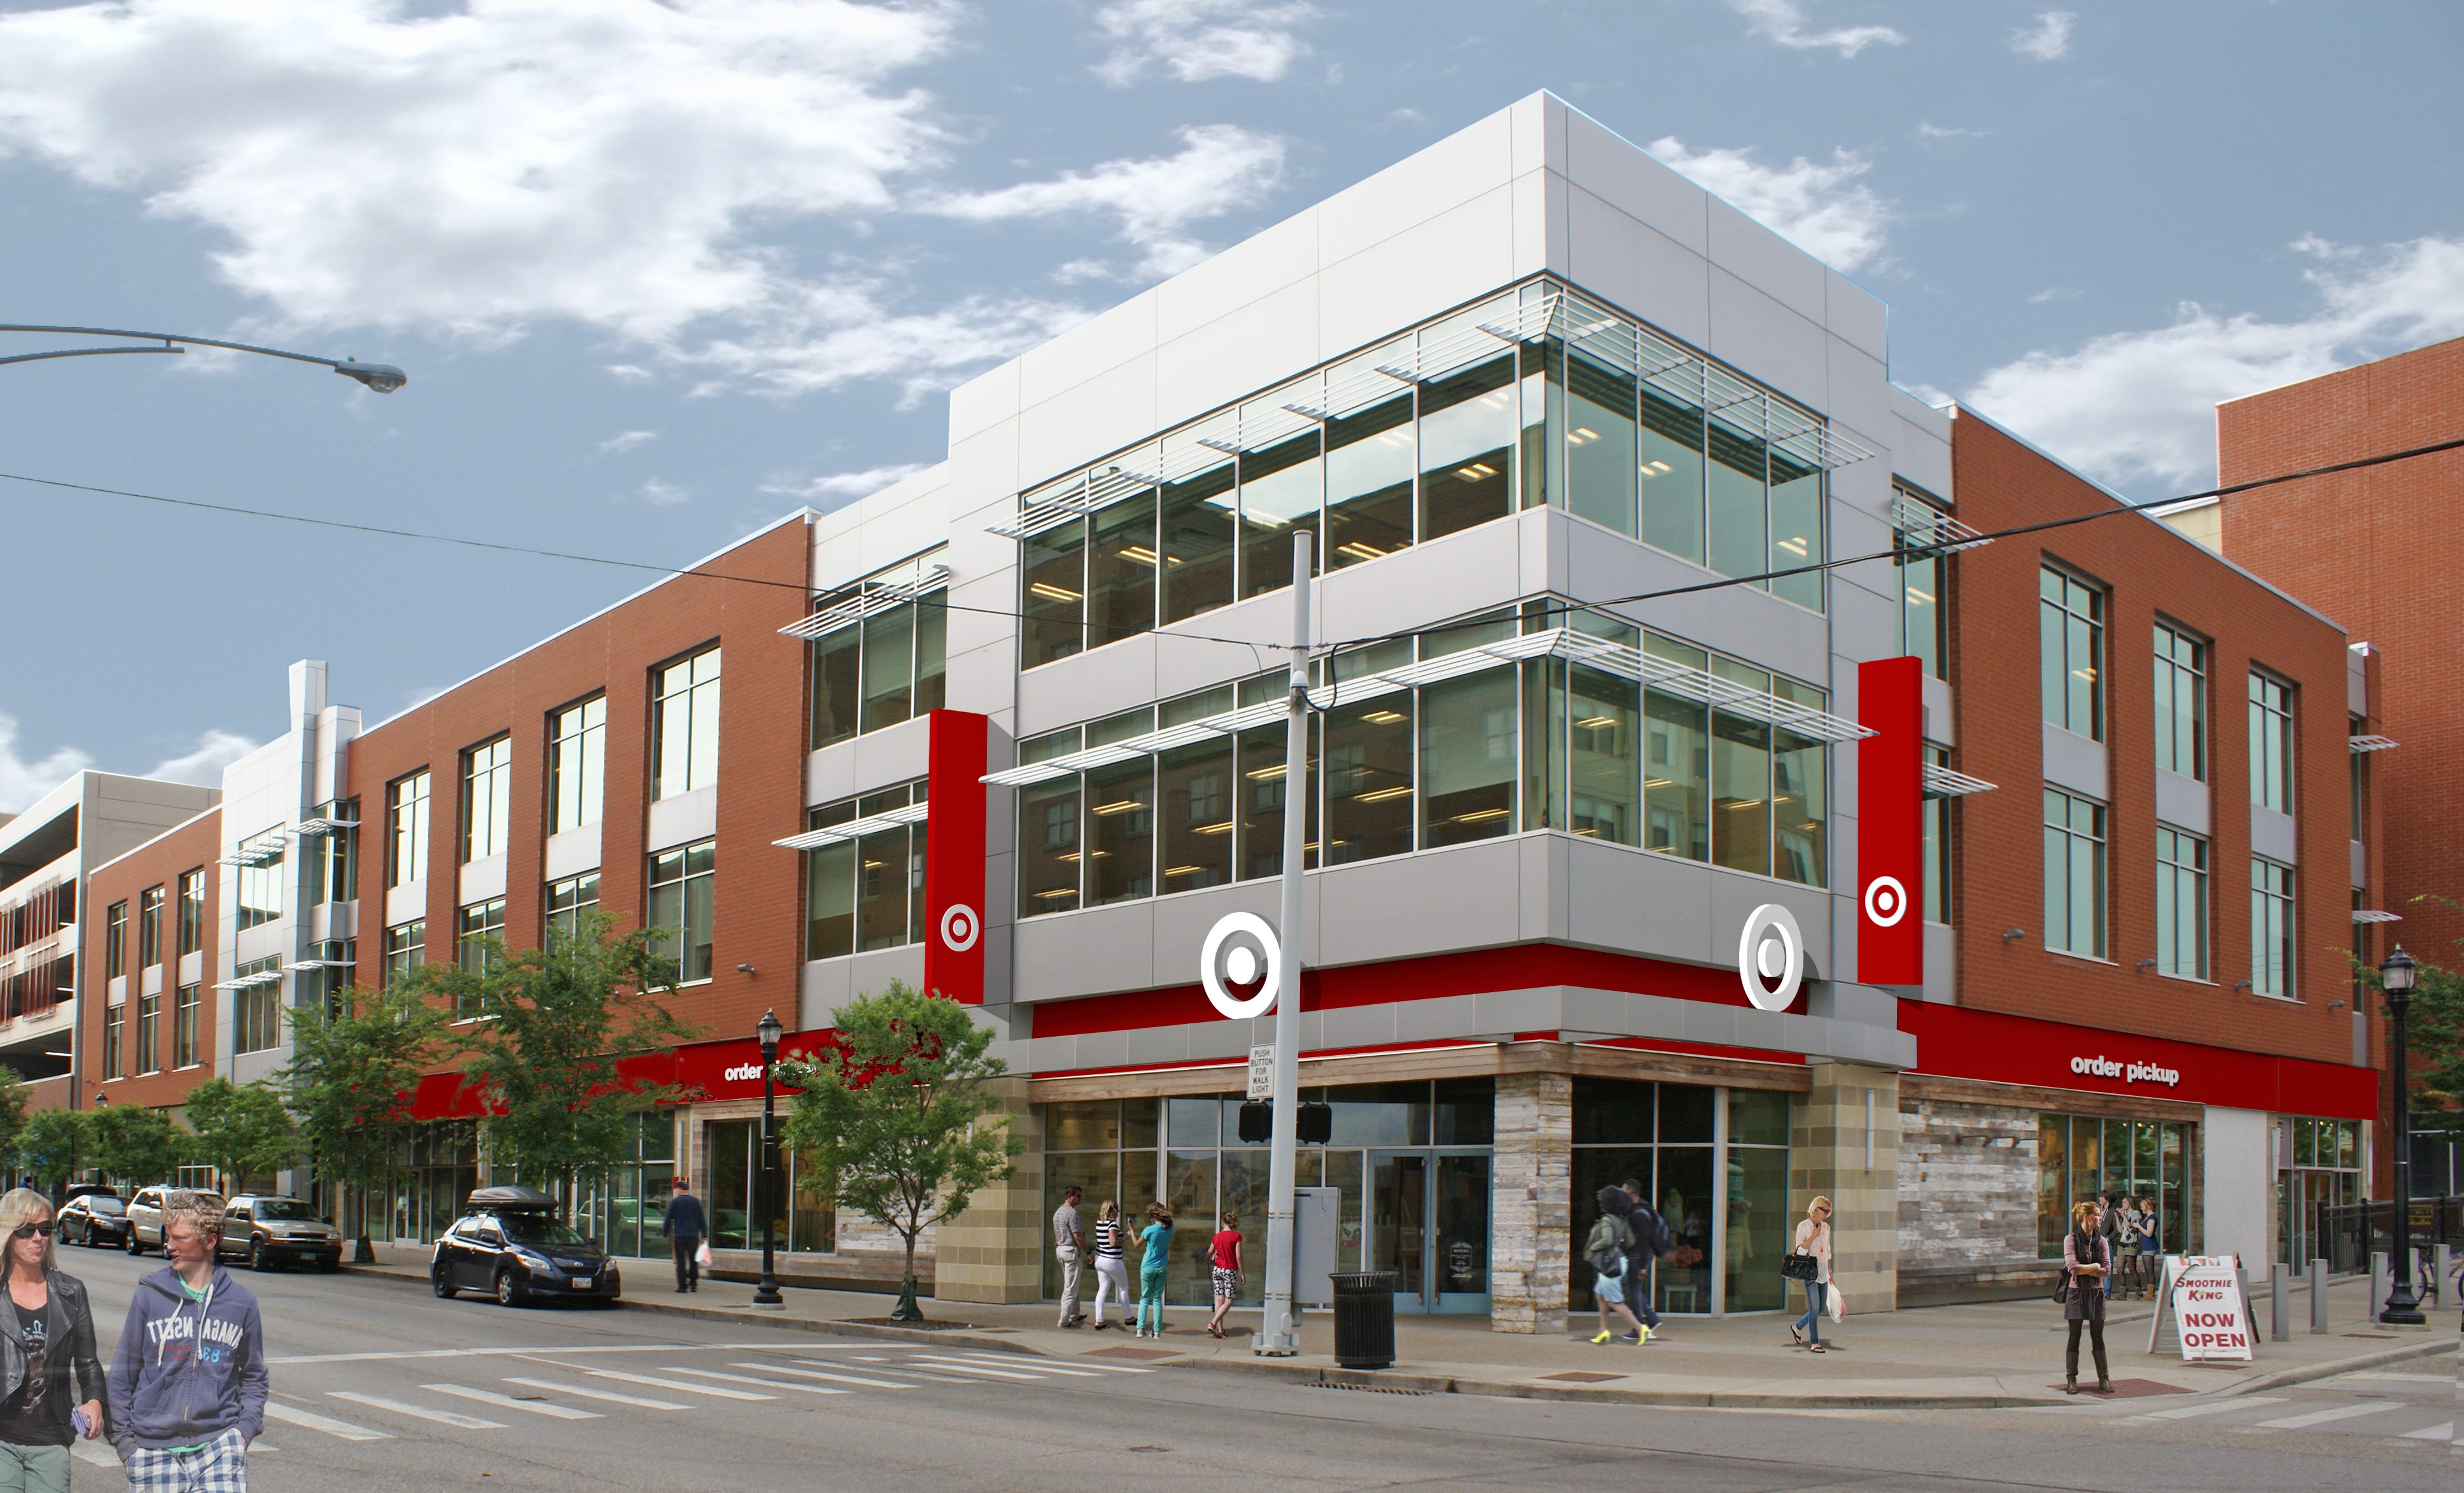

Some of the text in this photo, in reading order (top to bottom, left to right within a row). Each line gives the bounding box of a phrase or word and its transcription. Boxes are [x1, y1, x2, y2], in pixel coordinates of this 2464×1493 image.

[1250, 1058, 1273, 1067] BUTTON
[724, 1062, 764, 1081] order
[1256, 1067, 1267, 1076] FOR
[2070, 1055, 2180, 1087] order pickup
[1252, 1085, 1268, 1093] LIGHT
[2185, 1313, 2234, 1328] NOW
[2184, 1333, 2246, 1347] OPEN
